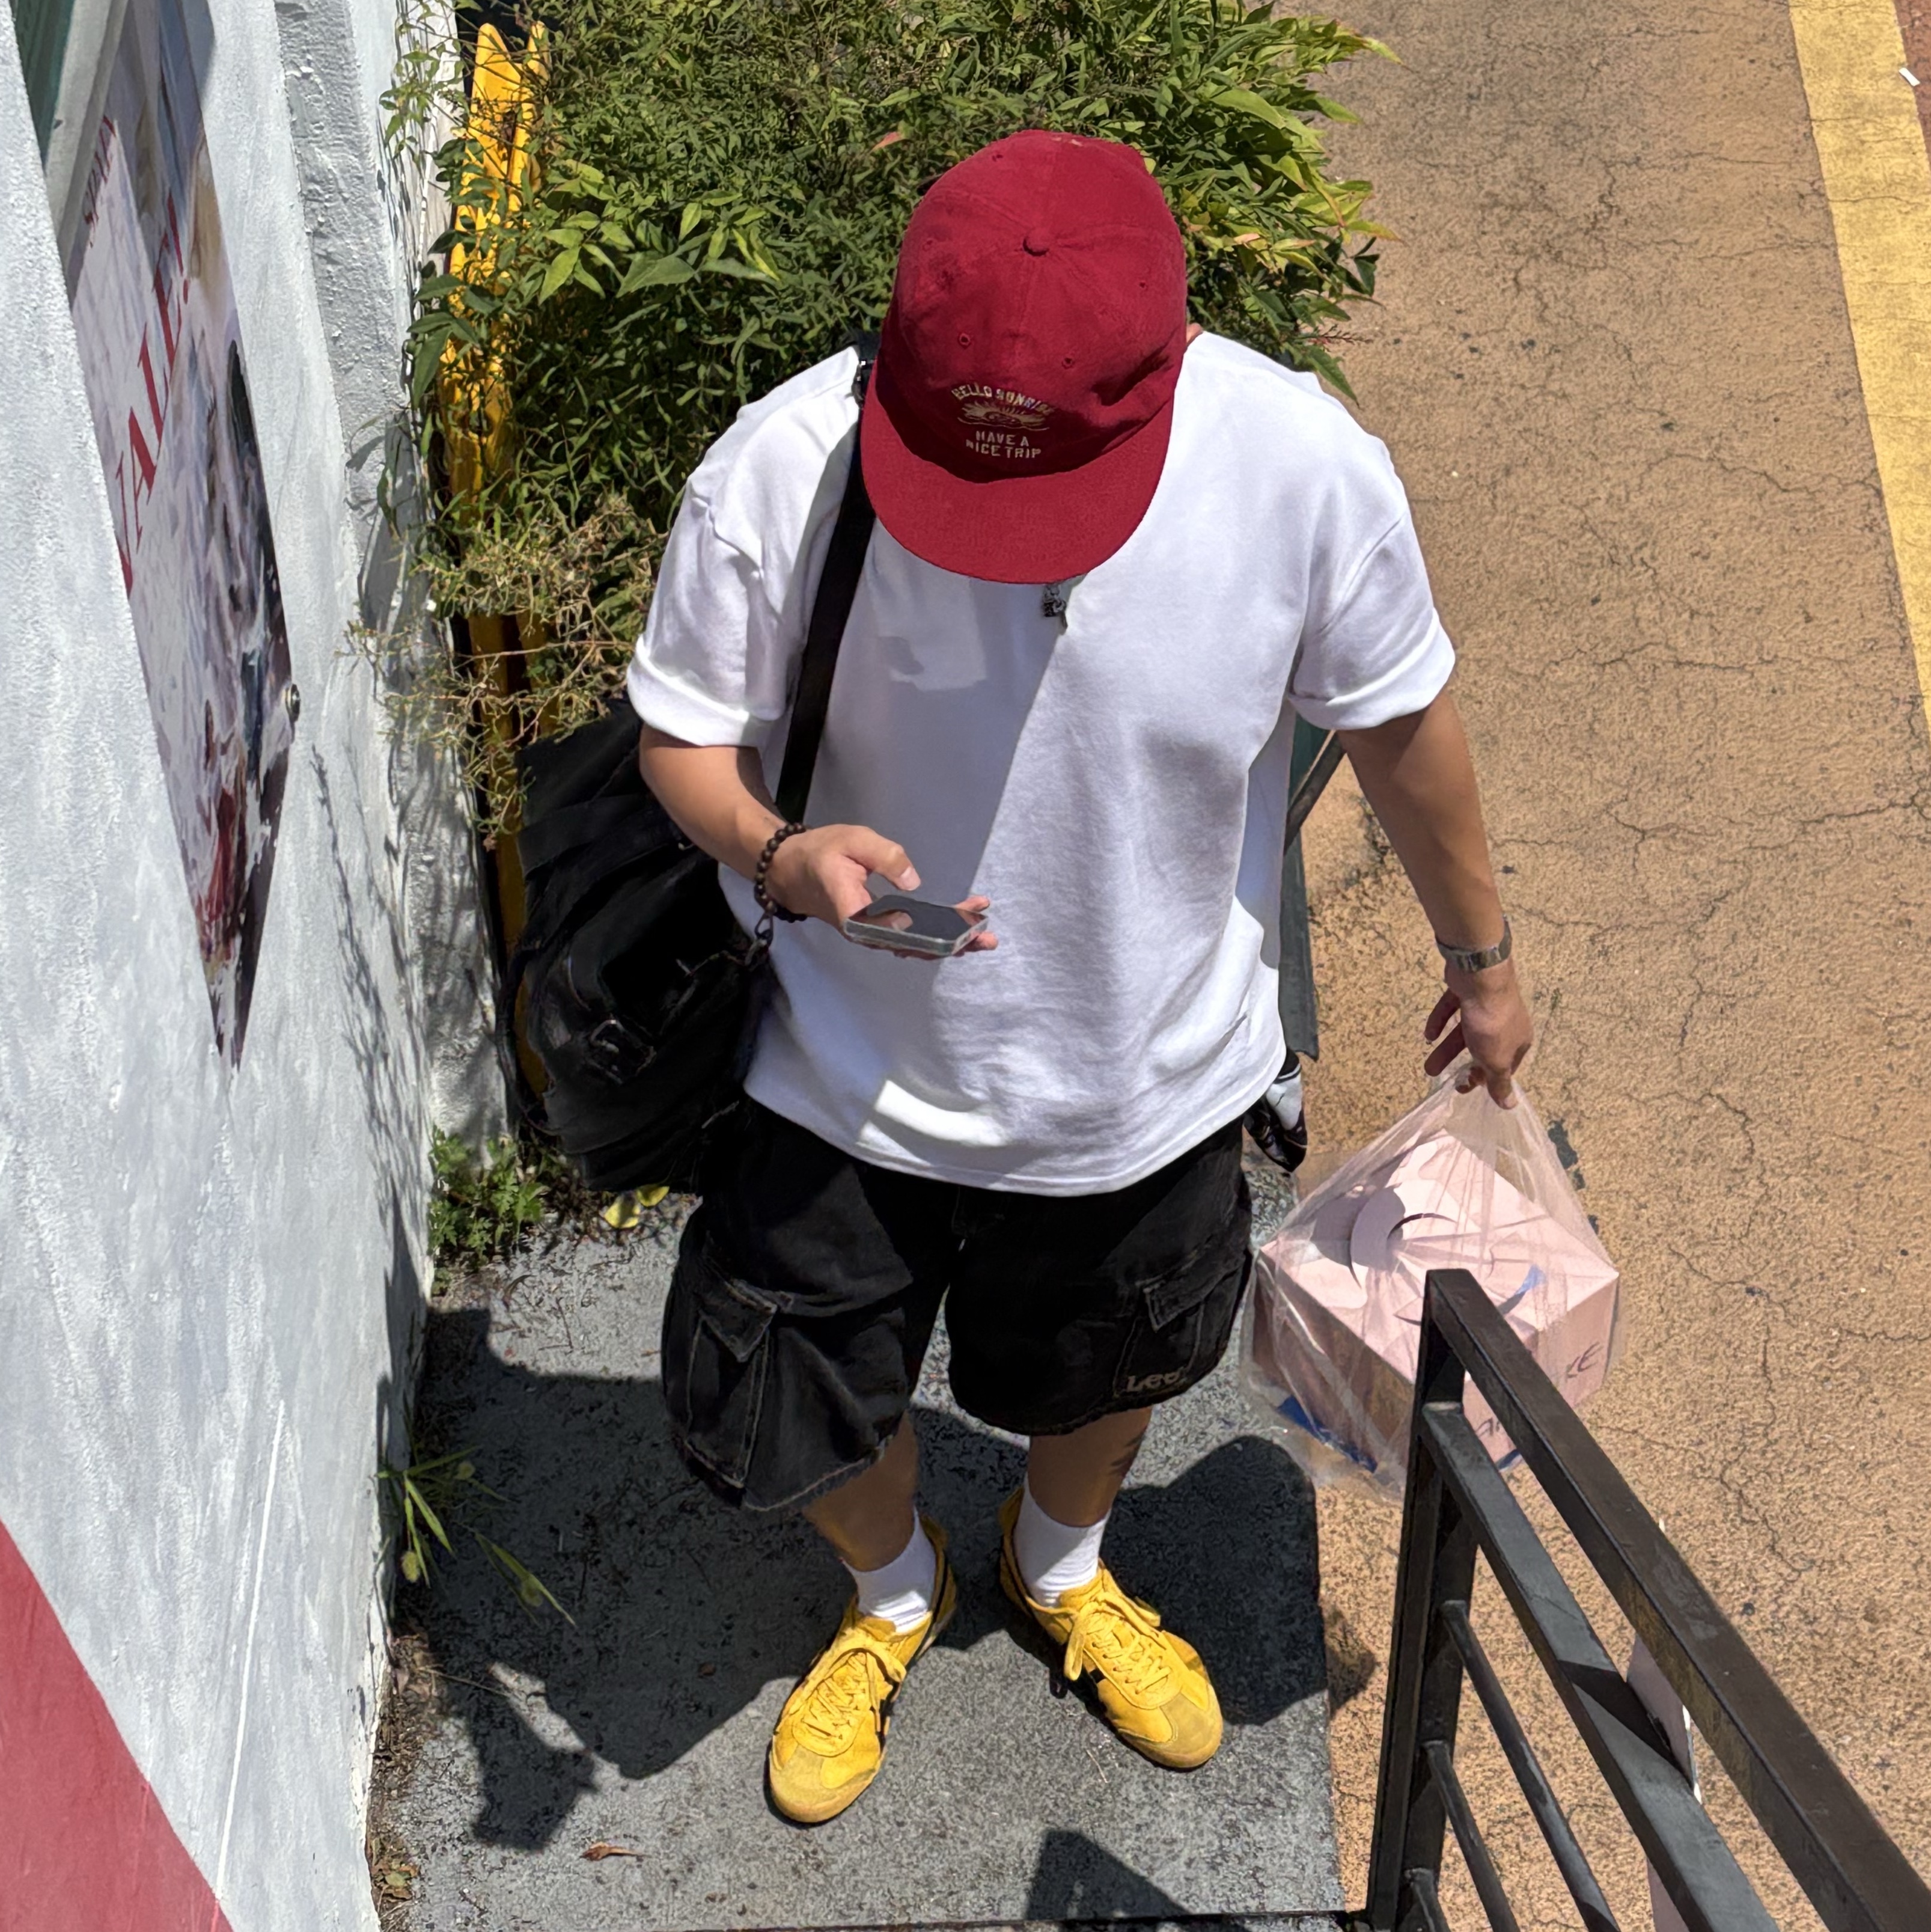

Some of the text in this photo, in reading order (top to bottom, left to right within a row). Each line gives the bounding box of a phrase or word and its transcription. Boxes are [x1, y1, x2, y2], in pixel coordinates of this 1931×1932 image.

[976, 430, 1029, 447] HAVE A
[965, 439, 1042, 459] NICE TRIP
